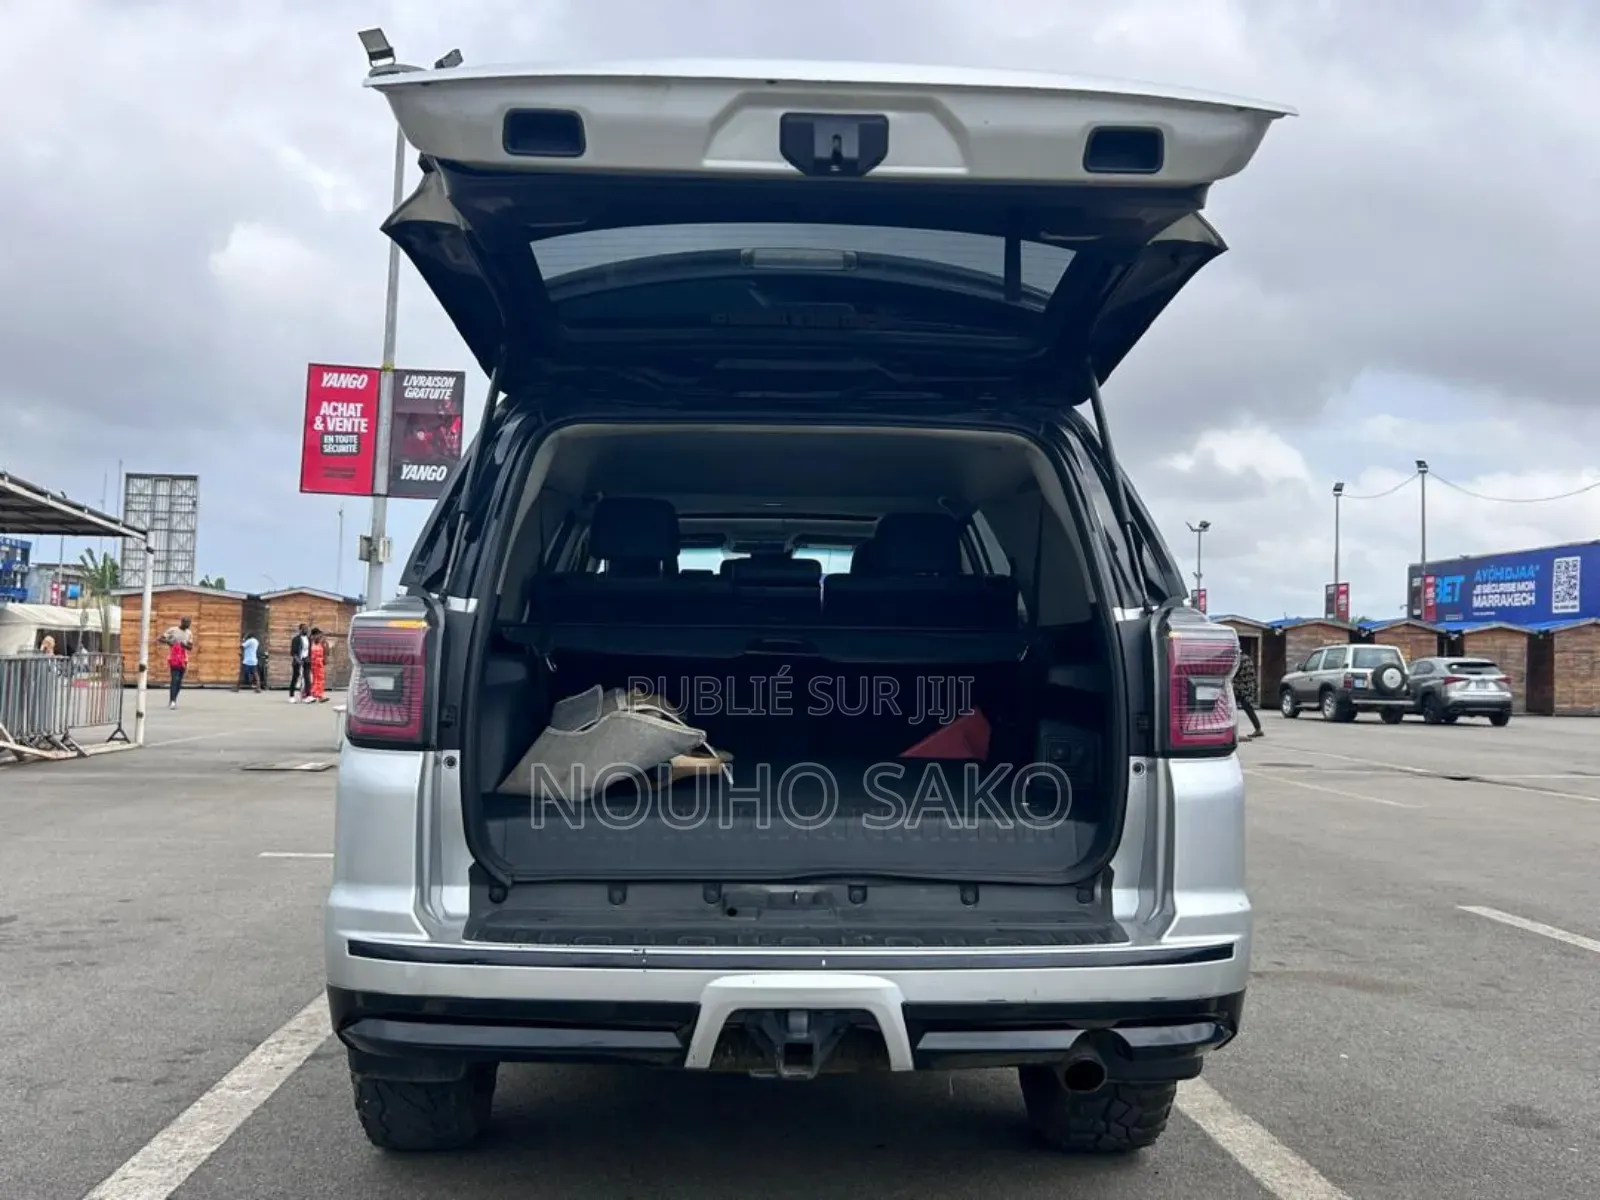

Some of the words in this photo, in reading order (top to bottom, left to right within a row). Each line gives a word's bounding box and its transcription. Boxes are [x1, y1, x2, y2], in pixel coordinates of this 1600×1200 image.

[321, 372, 368, 389] YANGO
[402, 374, 456, 388] LIVRAISON
[404, 387, 453, 400] GRATUITE
[320, 401, 364, 417] ACHAT
[313, 416, 325, 431] &
[326, 417, 369, 433] VENTE
[323, 434, 334, 444] EN
[335, 434, 358, 444] TOUTE
[400, 464, 448, 482] YANGO
[1516, 580, 1536, 592] MON
[1472, 592, 1536, 609] MARRAKECH
